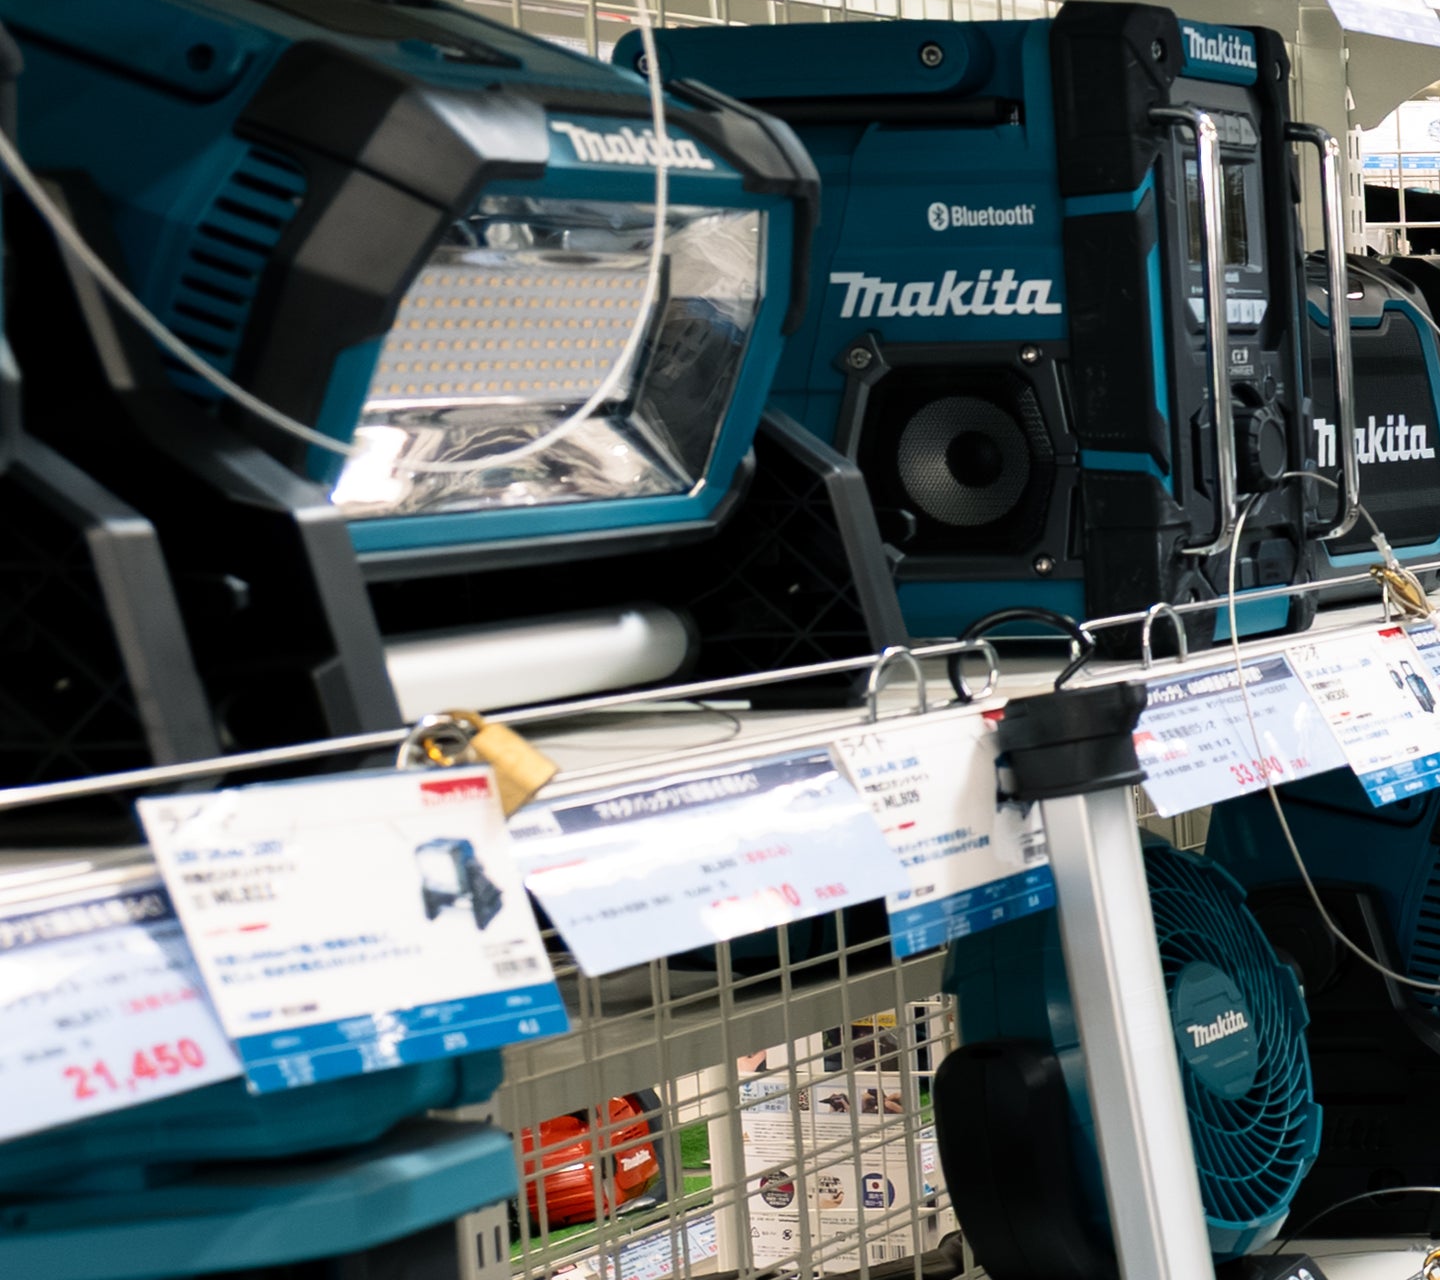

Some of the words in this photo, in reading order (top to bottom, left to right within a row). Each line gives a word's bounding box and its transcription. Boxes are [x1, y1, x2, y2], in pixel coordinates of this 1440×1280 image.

[1182, 31, 1258, 69] Makita
[551, 119, 717, 173] Makita
[949, 201, 1032, 228] Bluetooth
[827, 267, 1064, 321] Makita
[1186, 1009, 1251, 1050] Makita
[60, 1037, 207, 1102] 21,450
